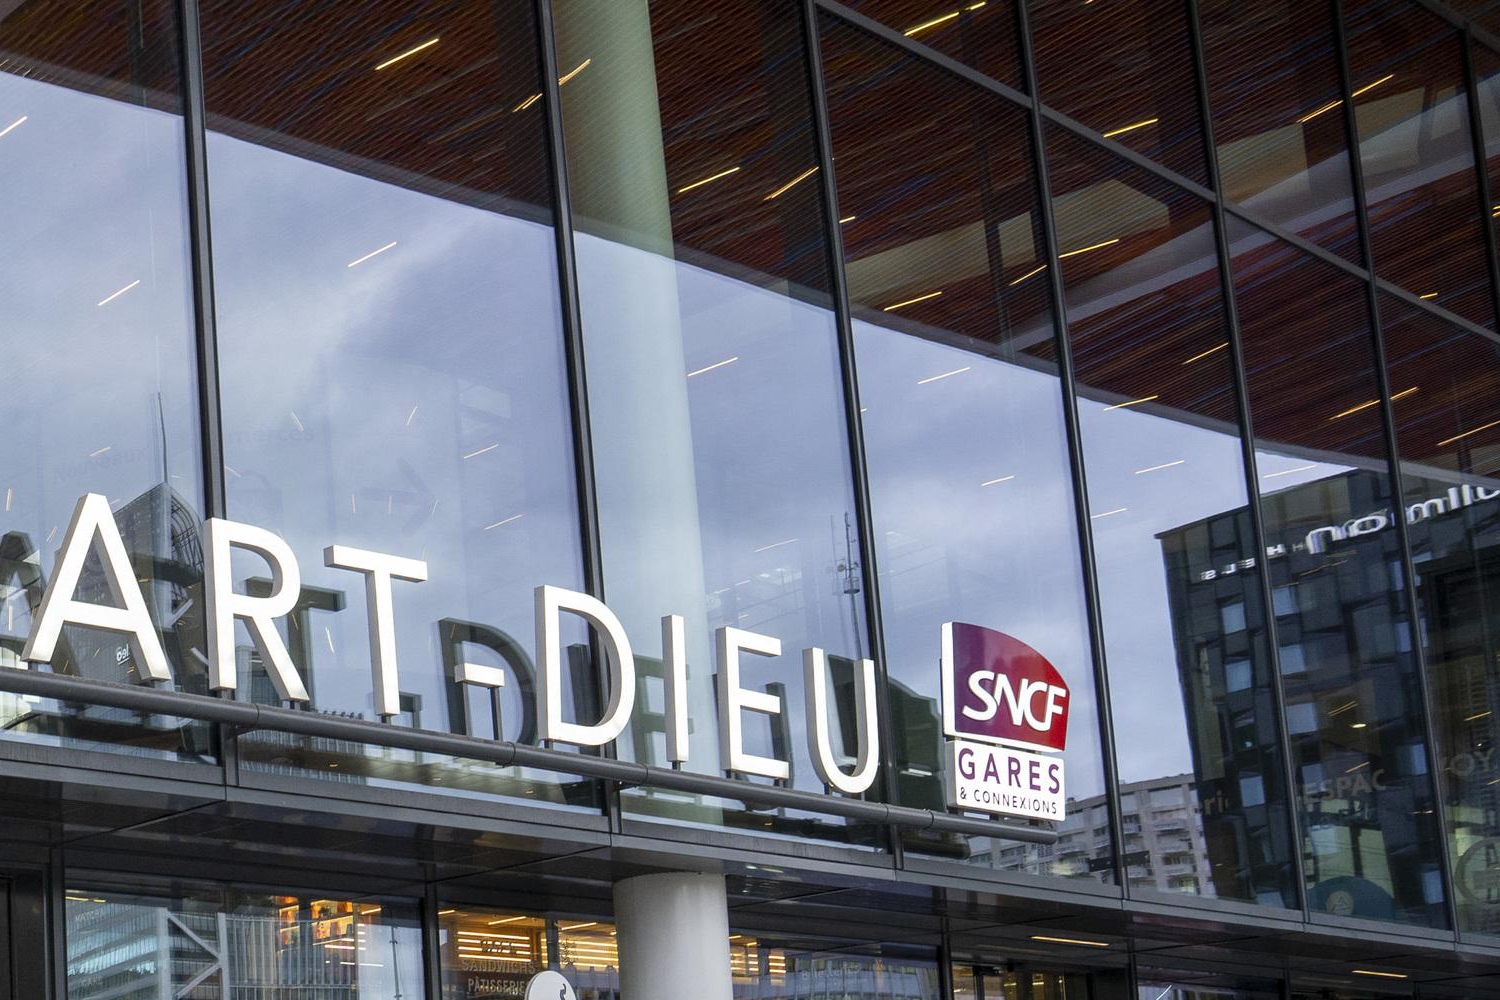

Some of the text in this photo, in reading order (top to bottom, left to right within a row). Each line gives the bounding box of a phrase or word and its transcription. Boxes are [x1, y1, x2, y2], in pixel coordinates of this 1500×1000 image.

[961, 669, 1068, 732] SNCF
[957, 747, 1062, 794] GARES
[959, 786, 1059, 814] & CONNEXIONS
[467, 976, 529, 994] PÂTISSERIE
